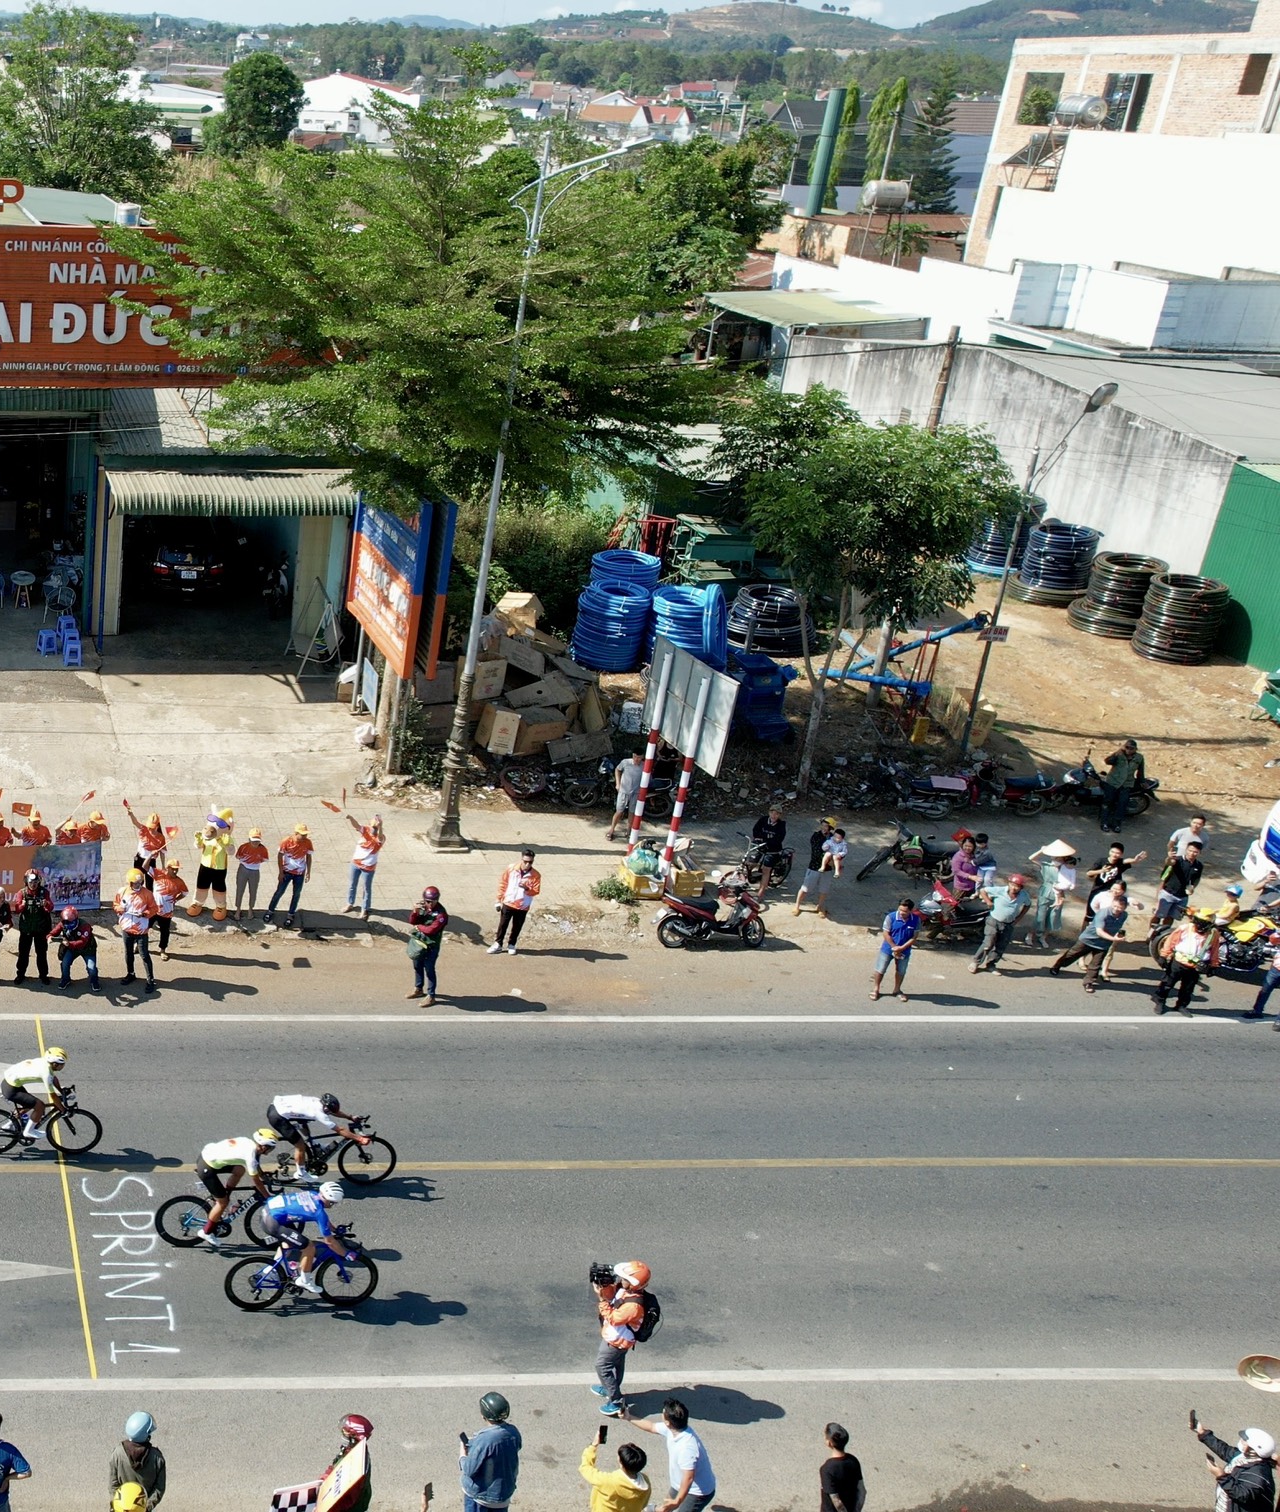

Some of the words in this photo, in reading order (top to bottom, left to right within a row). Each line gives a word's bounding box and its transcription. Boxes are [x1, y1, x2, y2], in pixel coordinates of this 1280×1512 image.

[5, 240, 27, 252] CHI
[31, 238, 82, 253] NHÁNH
[49, 257, 107, 285] NHÀ
[49, 291, 173, 347] ĐỨC
